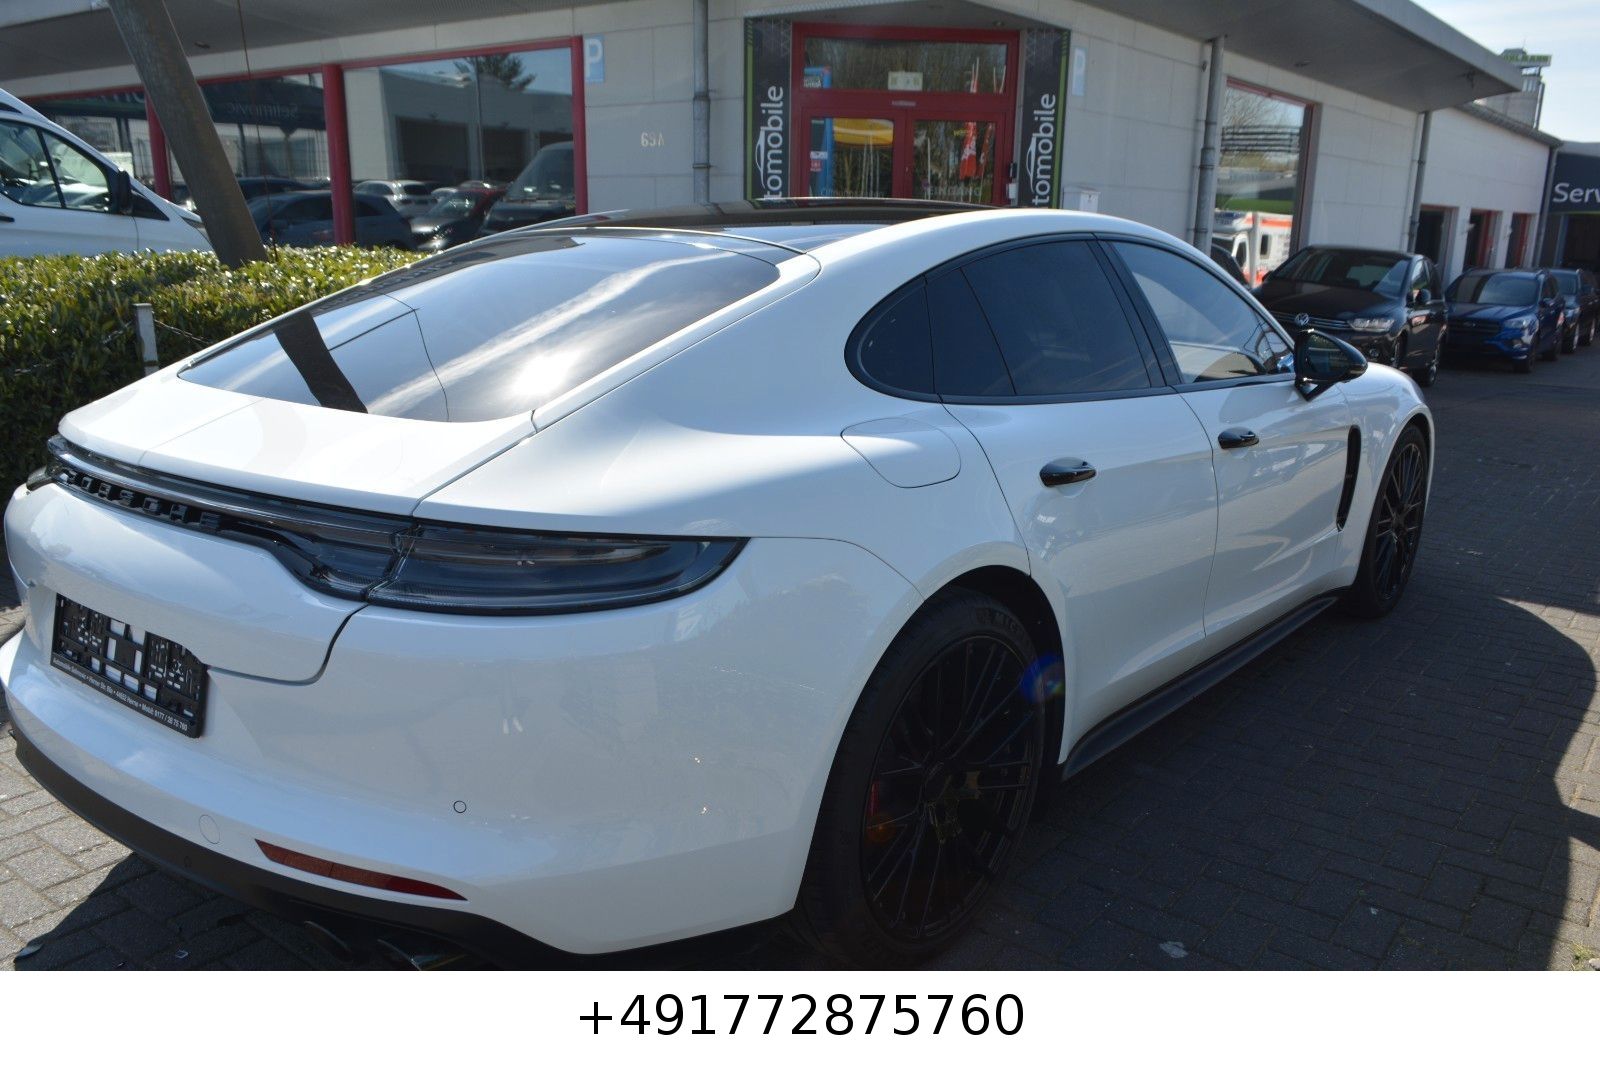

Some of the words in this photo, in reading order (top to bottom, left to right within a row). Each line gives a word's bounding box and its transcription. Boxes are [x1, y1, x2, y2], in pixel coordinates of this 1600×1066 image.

[584, 38, 603, 79] P
[760, 85, 784, 201] tomobile
[1032, 93, 1057, 206] tomobile
[62, 467, 222, 530] PORSCHE
